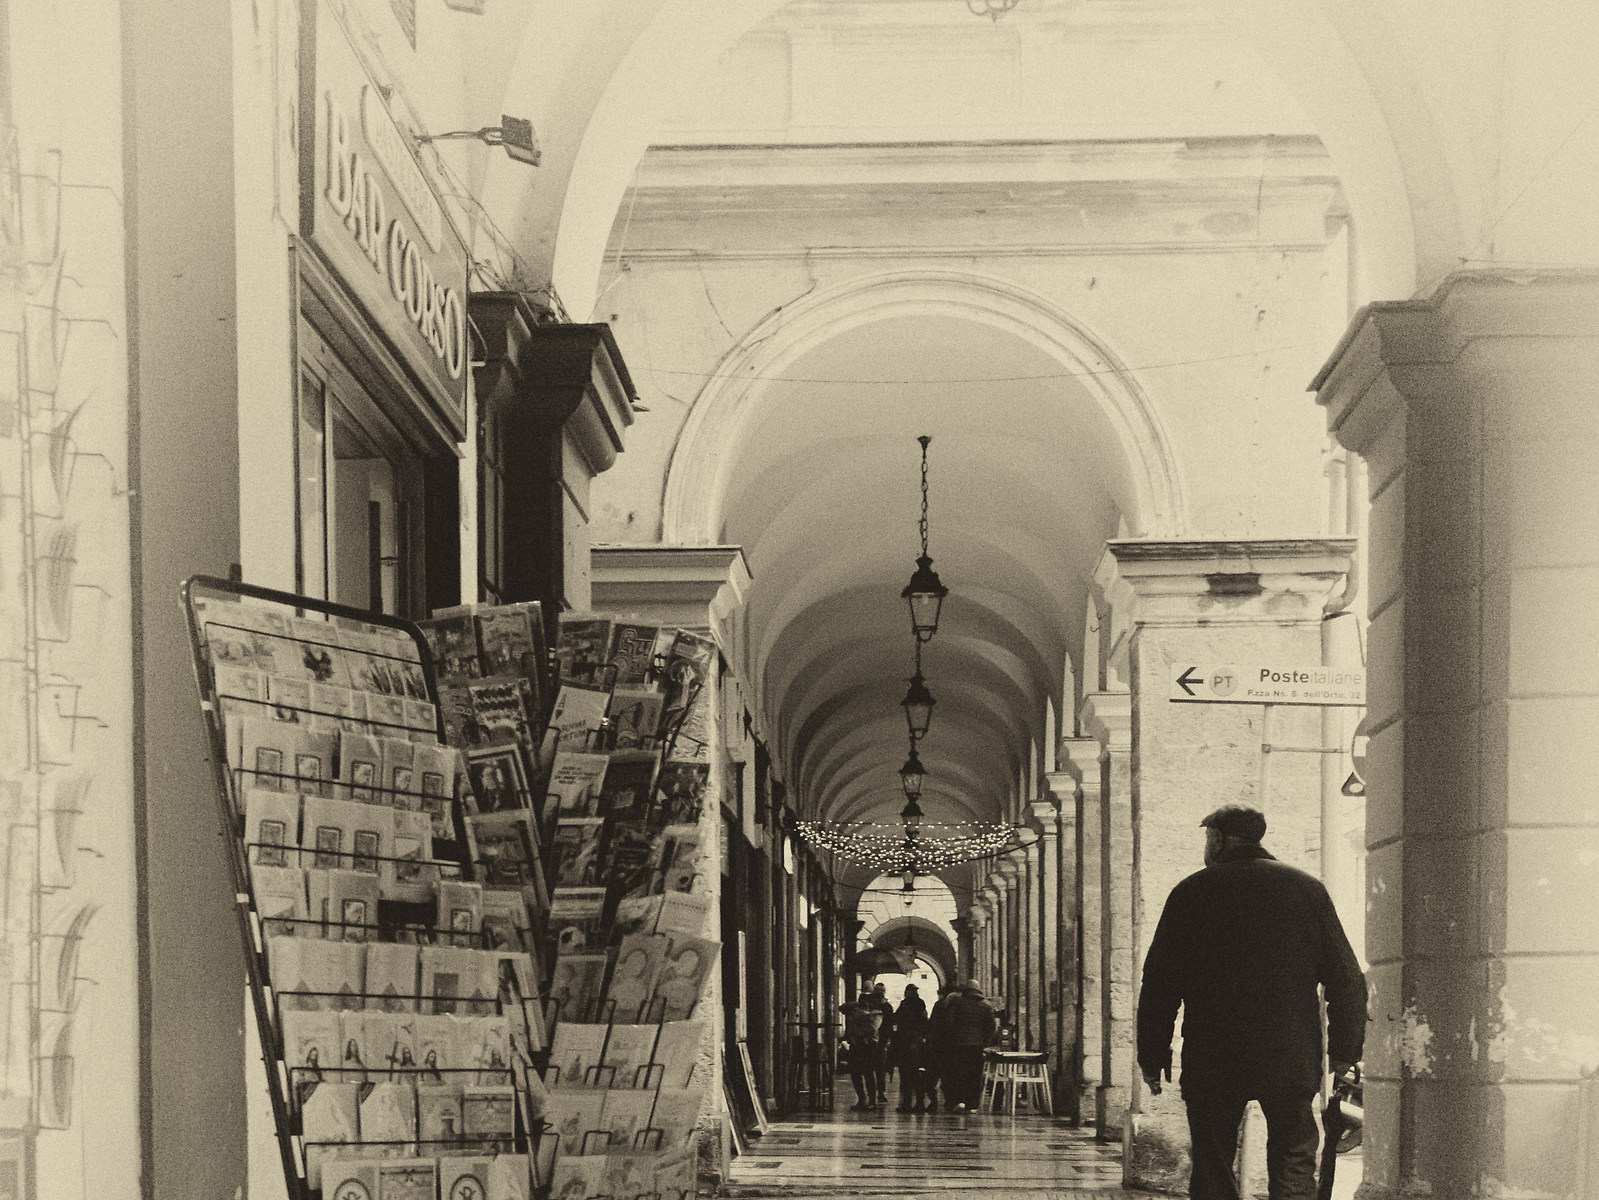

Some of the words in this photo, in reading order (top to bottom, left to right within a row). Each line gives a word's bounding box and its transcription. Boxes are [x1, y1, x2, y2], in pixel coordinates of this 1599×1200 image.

[325, 90, 384, 274] BAR
[387, 219, 463, 380] CORSO
[1213, 676, 1233, 688] PT
